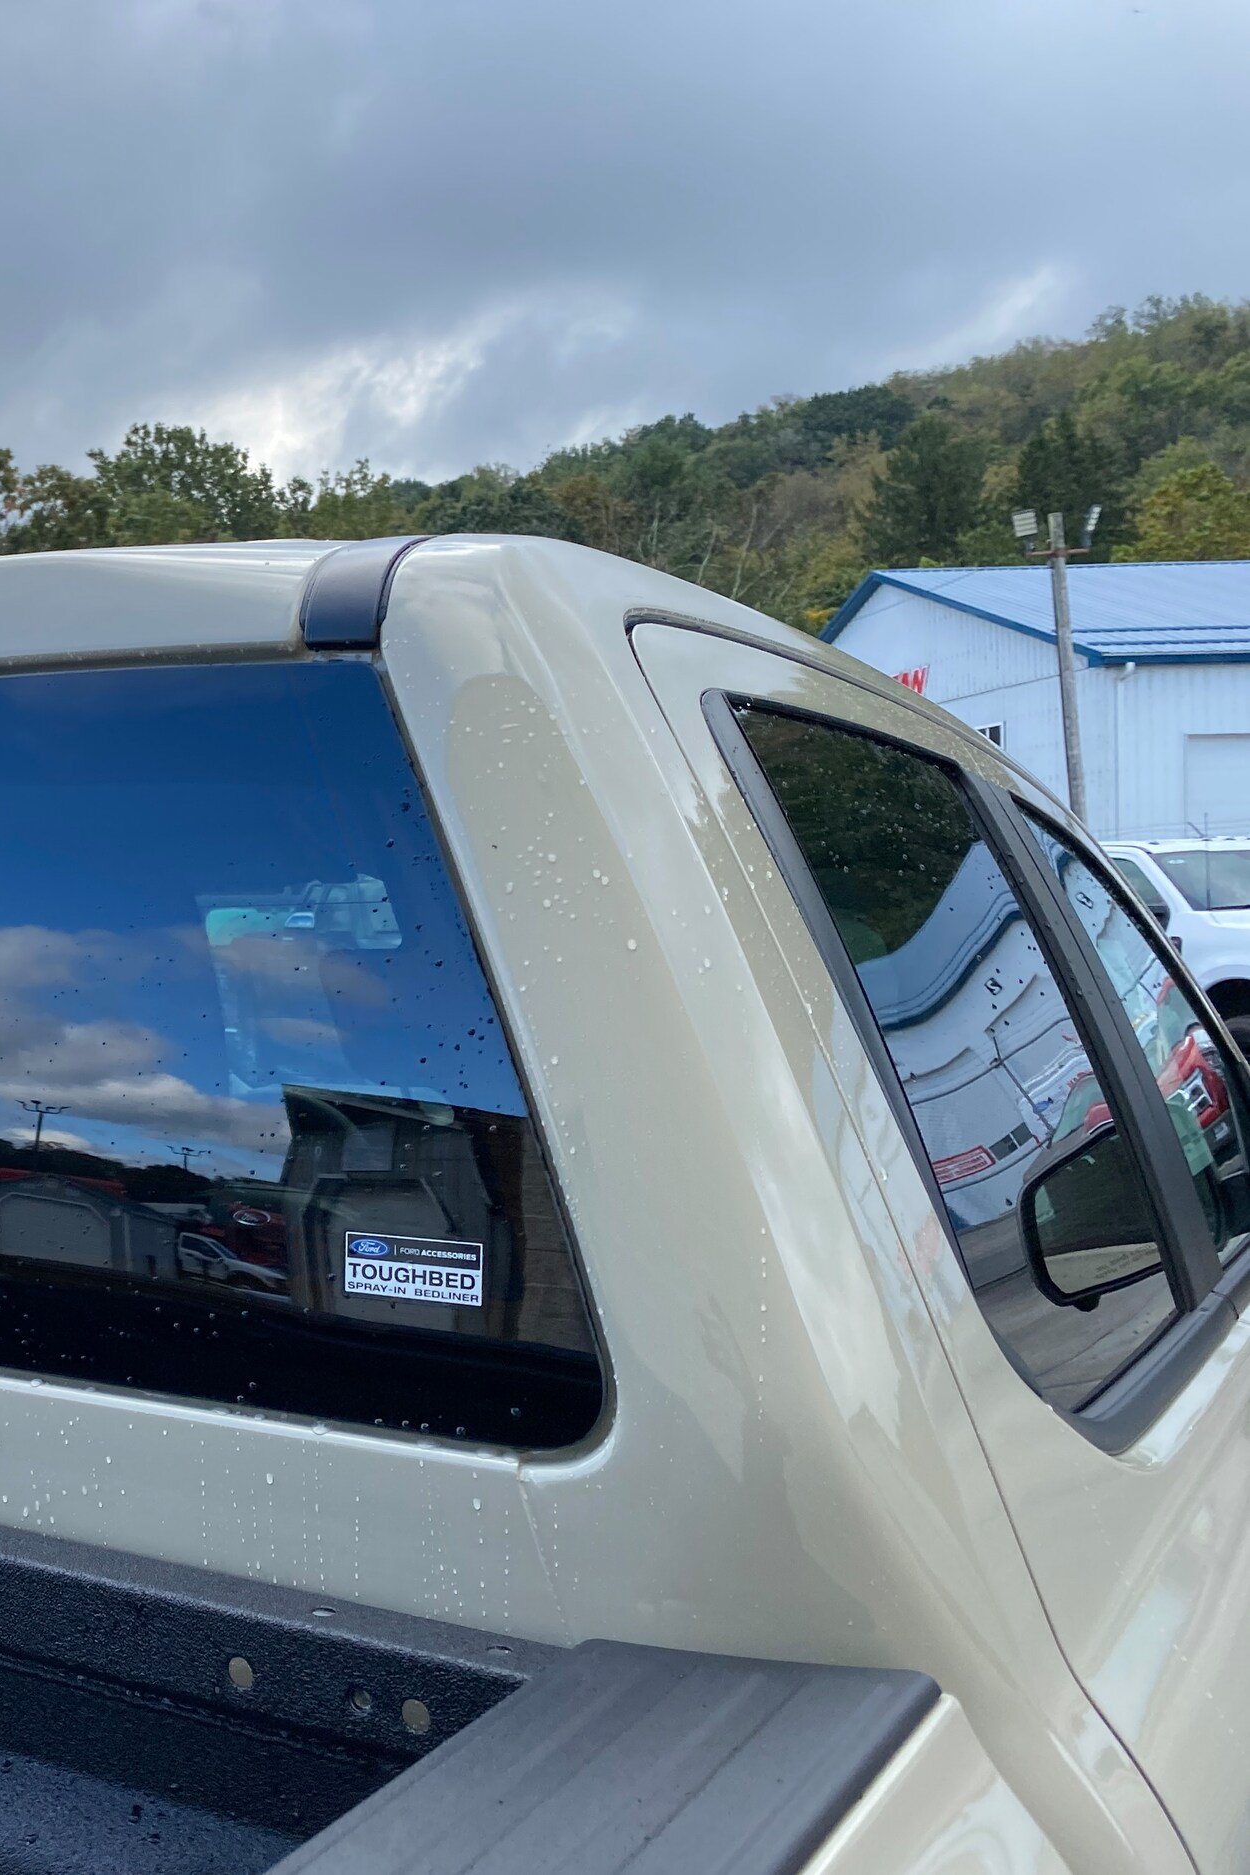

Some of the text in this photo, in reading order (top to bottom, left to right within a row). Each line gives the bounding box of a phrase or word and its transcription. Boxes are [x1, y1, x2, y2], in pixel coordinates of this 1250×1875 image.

[358, 1241, 381, 1253] Ford
[400, 1247, 477, 1261] FORD ACCESSORIES
[348, 1262, 476, 1290] TOUGHBED
[348, 1281, 479, 1303] SPRAY-IN BEDLINER
